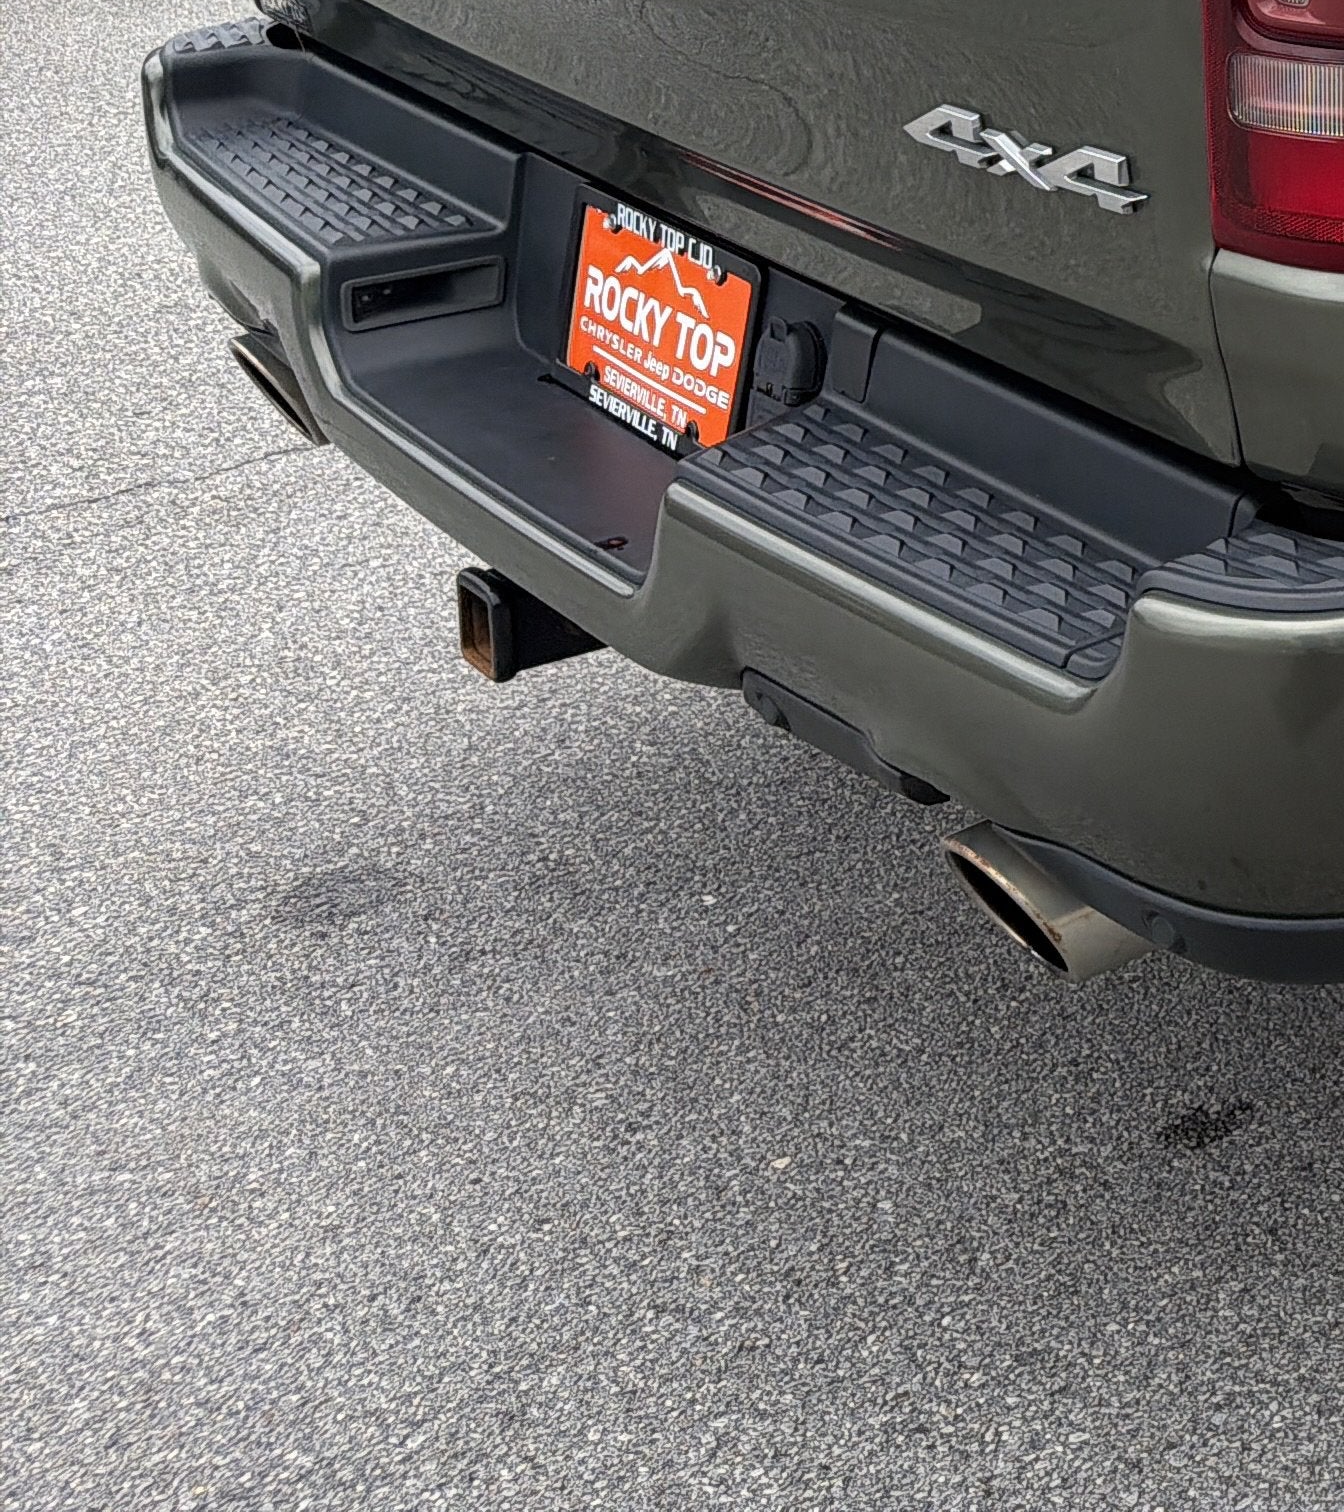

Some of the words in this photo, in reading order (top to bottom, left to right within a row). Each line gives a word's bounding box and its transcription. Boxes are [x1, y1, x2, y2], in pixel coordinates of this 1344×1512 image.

[616, 202, 656, 244] ROCKY
[659, 223, 685, 255] TOP
[687, 238, 715, 270] CJD
[583, 264, 673, 348] ROCKY
[675, 312, 736, 378] TOP
[579, 314, 643, 362] CHRYSLER
[643, 350, 670, 383] Jeep
[671, 366, 730, 410] DODGE
[588, 384, 658, 442] SEVIERVILLE,
[661, 426, 680, 451] TN
[603, 365, 668, 420] SEVIERVILLE,
[671, 407, 688, 429] TN
